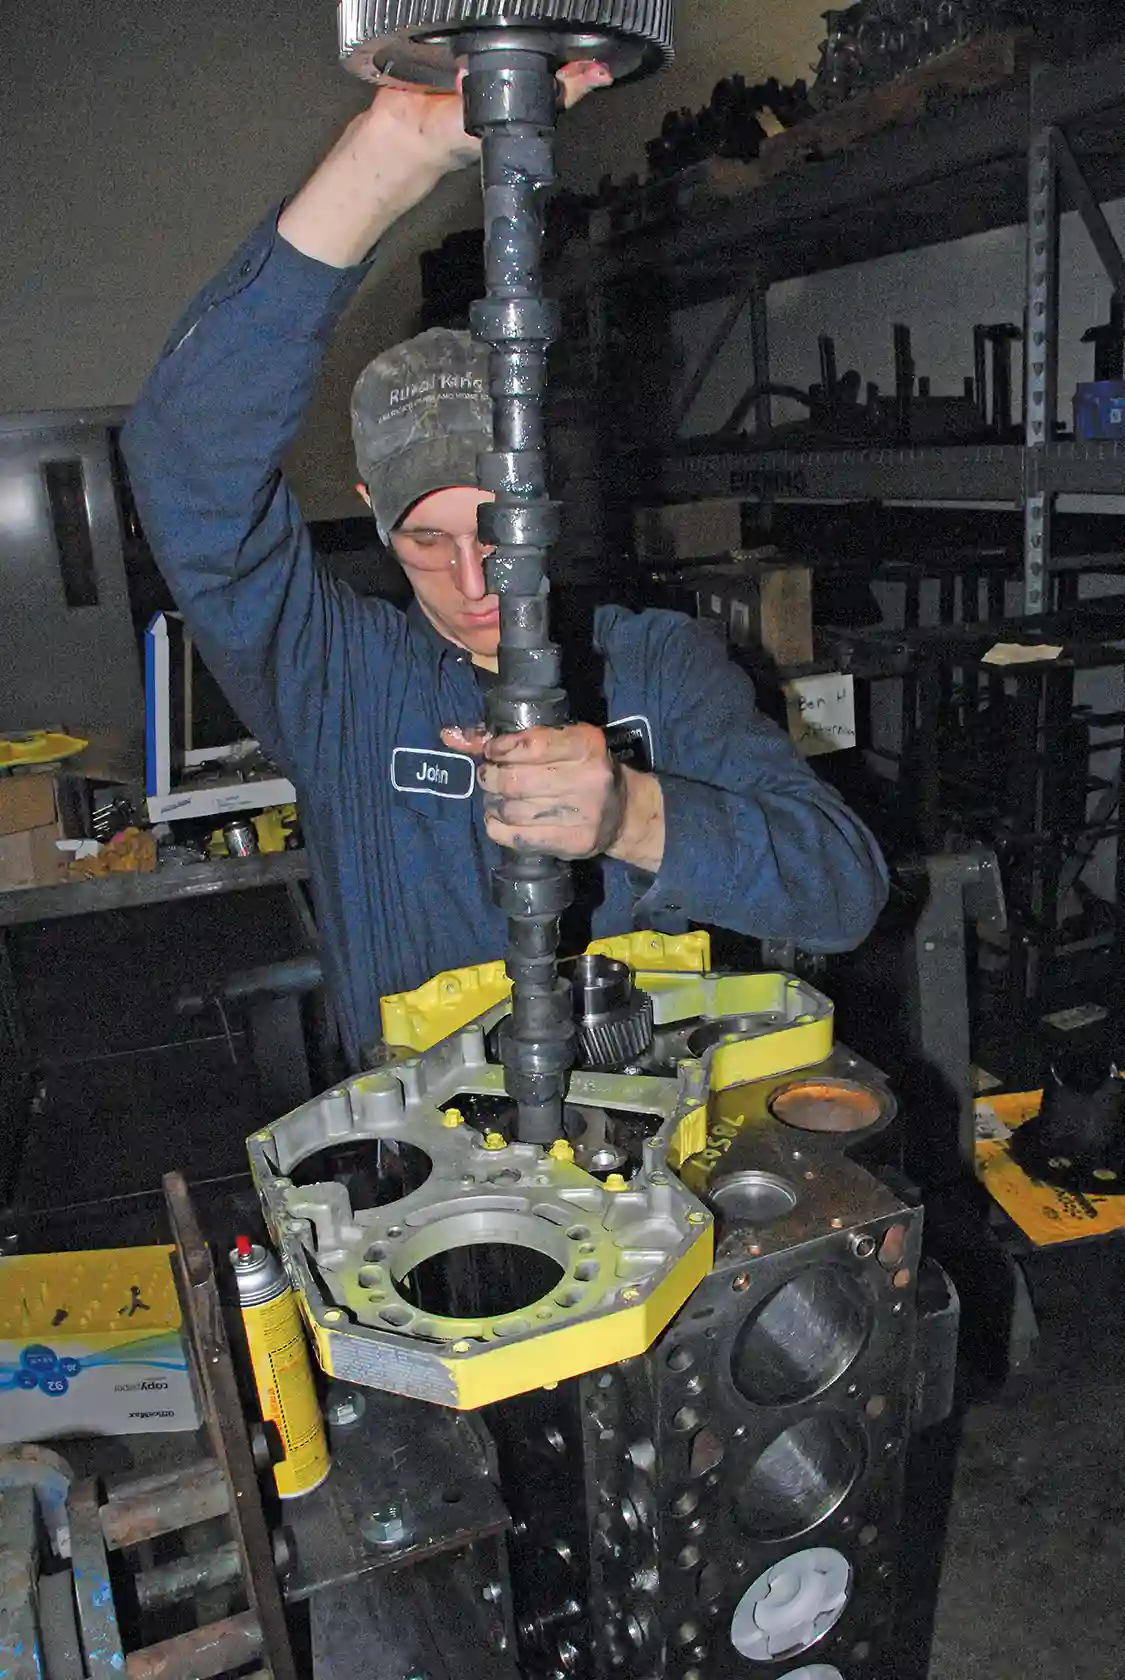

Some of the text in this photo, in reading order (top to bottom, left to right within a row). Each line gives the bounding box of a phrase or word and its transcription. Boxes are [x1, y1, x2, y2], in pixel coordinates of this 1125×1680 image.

[390, 371, 483, 405] Rural King
[416, 762, 449, 785] John
[48, 1381, 64, 1392] 92
[128, 1410, 175, 1419] OfficeMax
